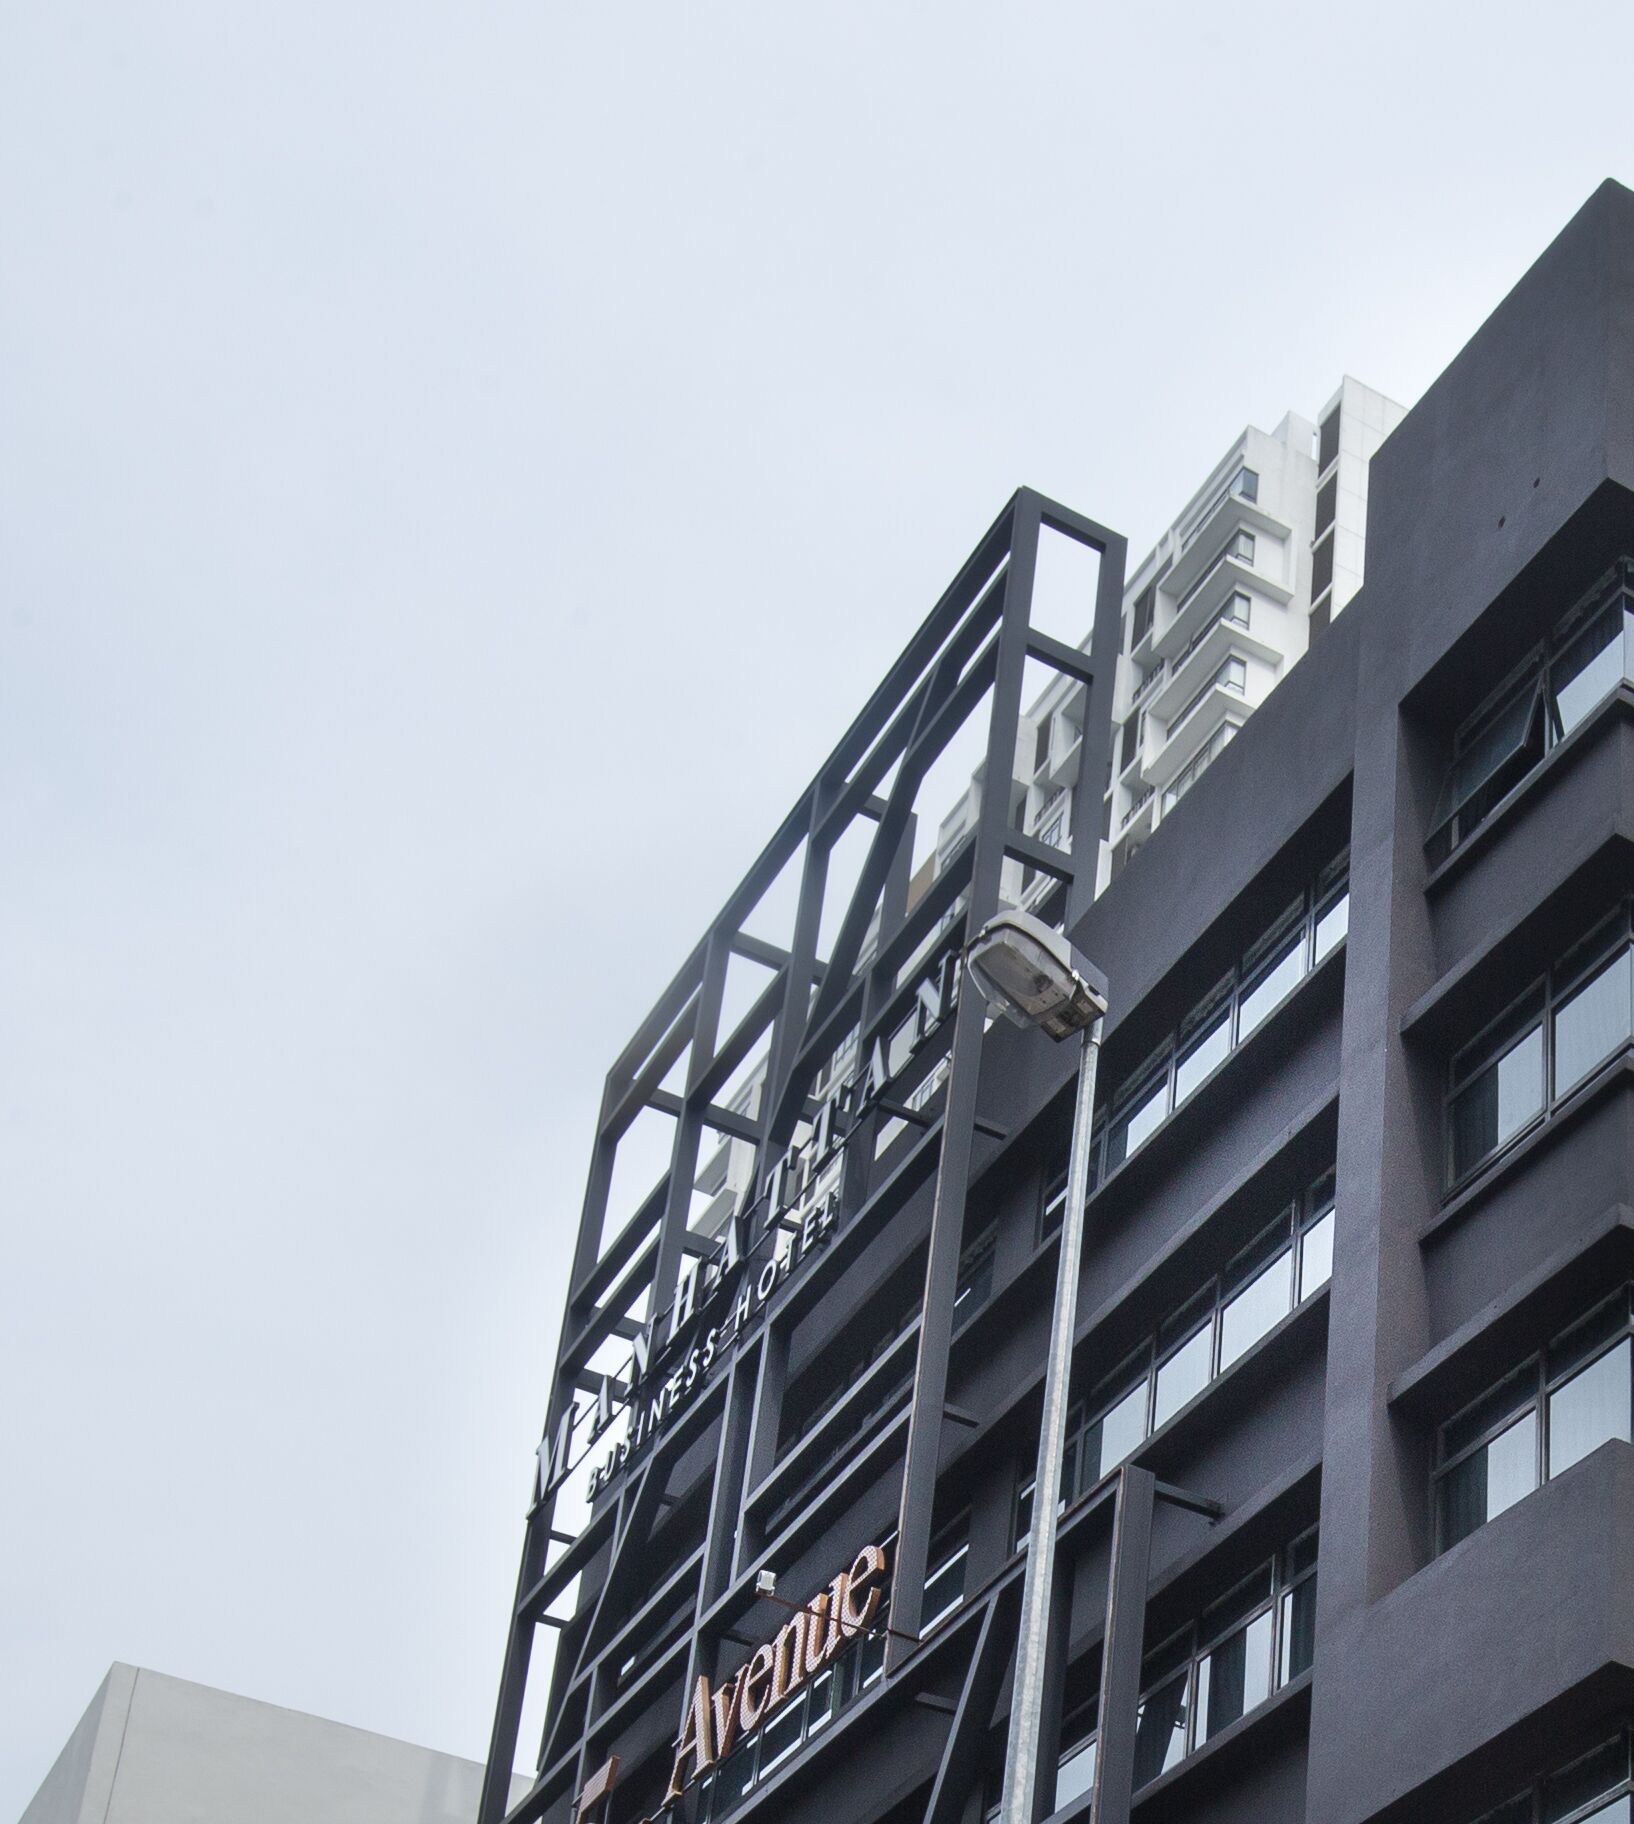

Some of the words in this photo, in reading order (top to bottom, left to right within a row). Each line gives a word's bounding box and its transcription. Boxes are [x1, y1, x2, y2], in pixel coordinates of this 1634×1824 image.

[585, 1327, 721, 1504] BUSINESS
[735, 1190, 840, 1335] HOTEL
[667, 1544, 886, 1803] Avenue
